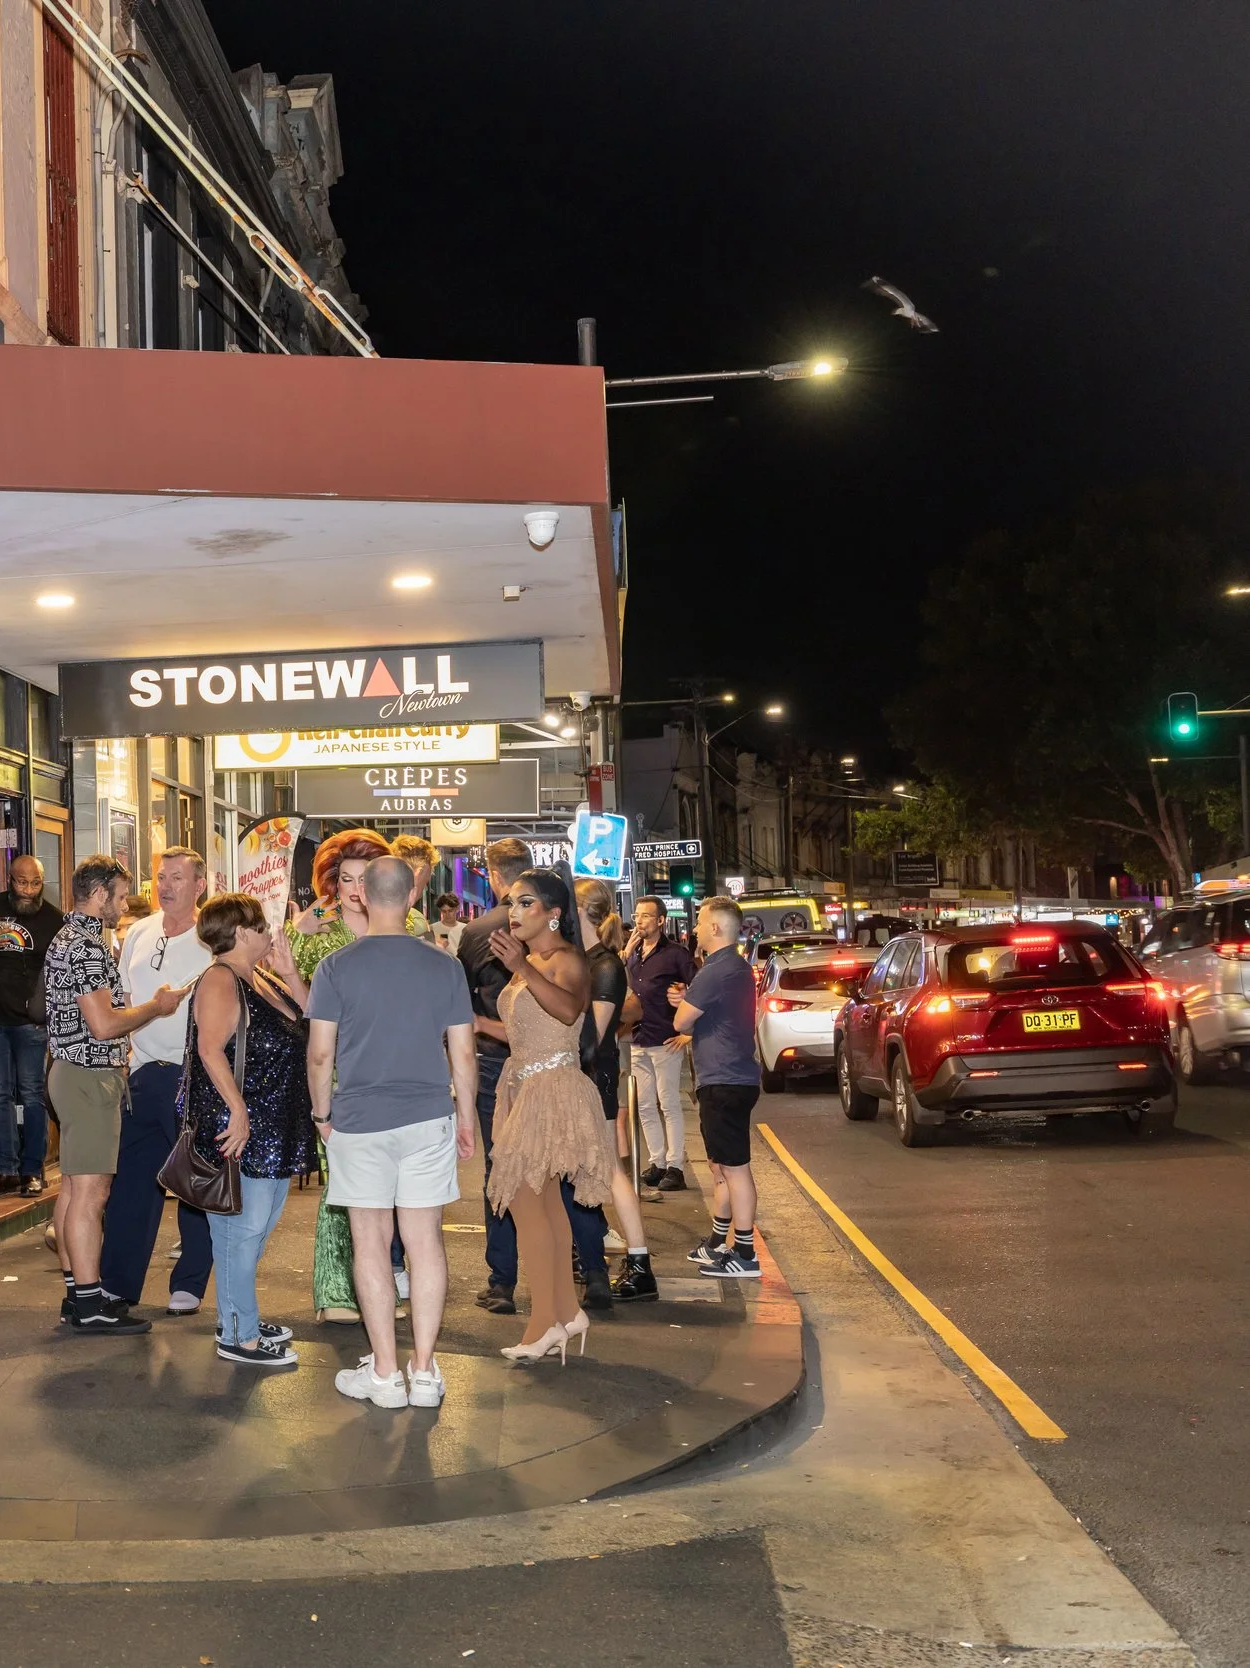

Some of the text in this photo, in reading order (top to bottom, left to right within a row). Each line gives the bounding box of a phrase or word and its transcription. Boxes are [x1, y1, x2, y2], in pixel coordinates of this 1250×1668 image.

[129, 655, 469, 708] STONEWALL
[380, 691, 462, 719] Newtown
[313, 740, 441, 754] JAPANESE STYLE
[364, 766, 468, 787] CRÊPES
[380, 799, 453, 811] AUBRAS
[588, 817, 613, 844] P
[634, 849, 685, 859] FRED HOSPITAL
[655, 843, 679, 851] PRINCE
[239, 855, 289, 887] moothies
